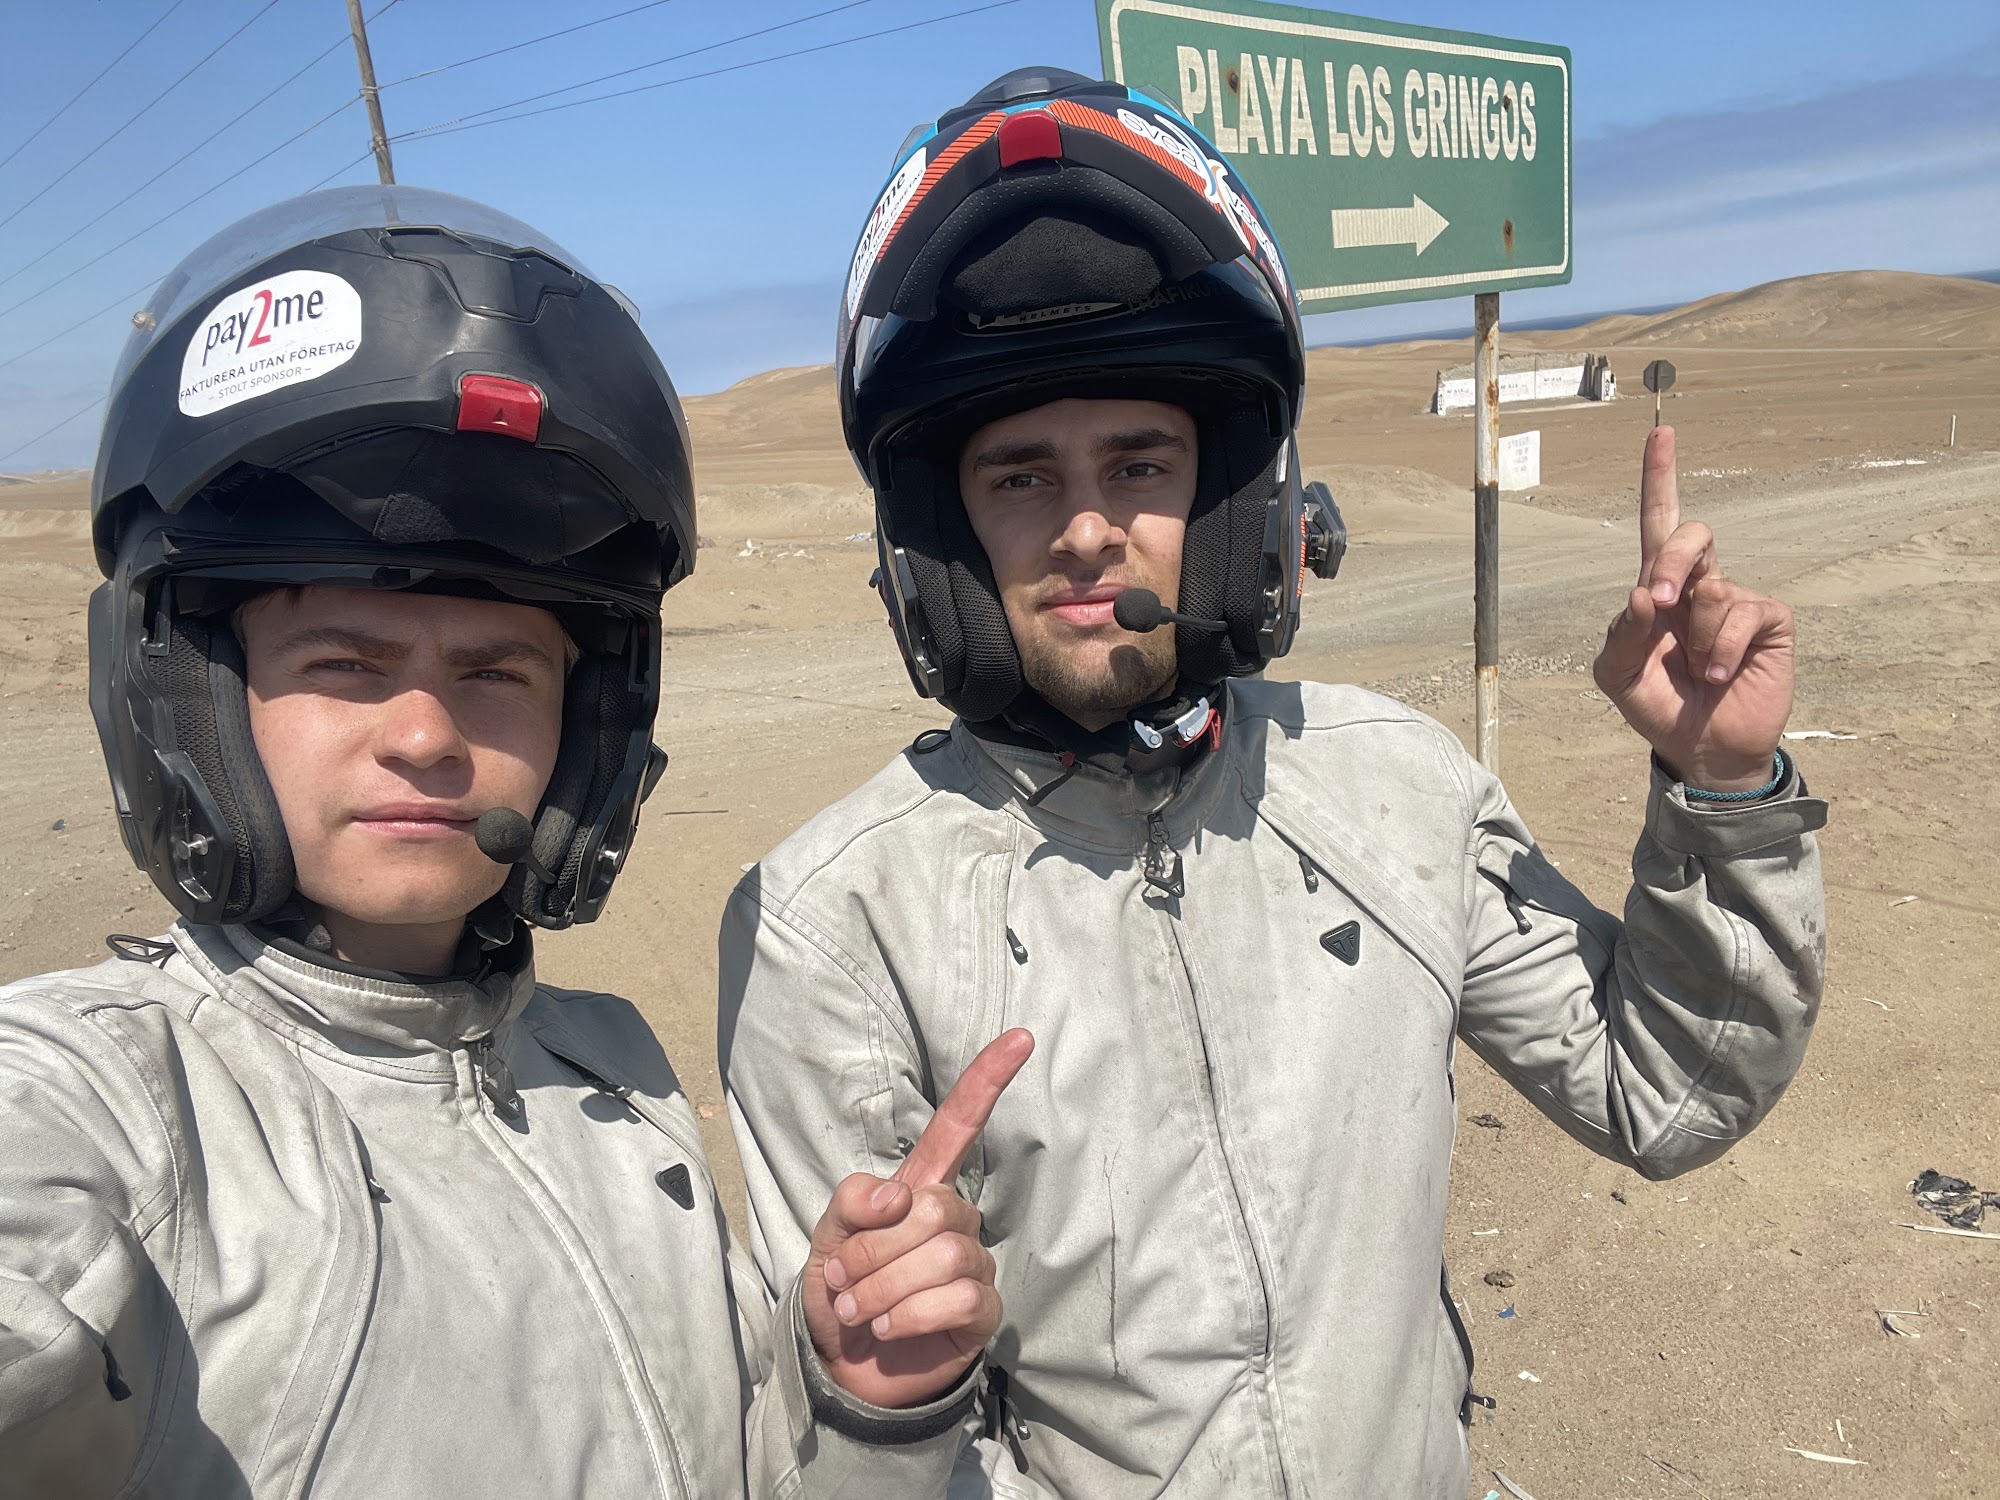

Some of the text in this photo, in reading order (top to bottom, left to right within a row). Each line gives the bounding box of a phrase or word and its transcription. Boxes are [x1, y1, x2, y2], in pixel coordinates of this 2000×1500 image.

[1176, 45, 1538, 162] PLAYA LOS GRINGOS
[1123, 112, 1201, 172] svea
[854, 172, 906, 281] pay2me
[202, 289, 324, 367] pay2me
[1019, 305, 1092, 322] HELMETS
[180, 340, 356, 401] FAKTURERA UTAN FÖRETAG
[218, 366, 303, 399] STOLT SPONSOR
